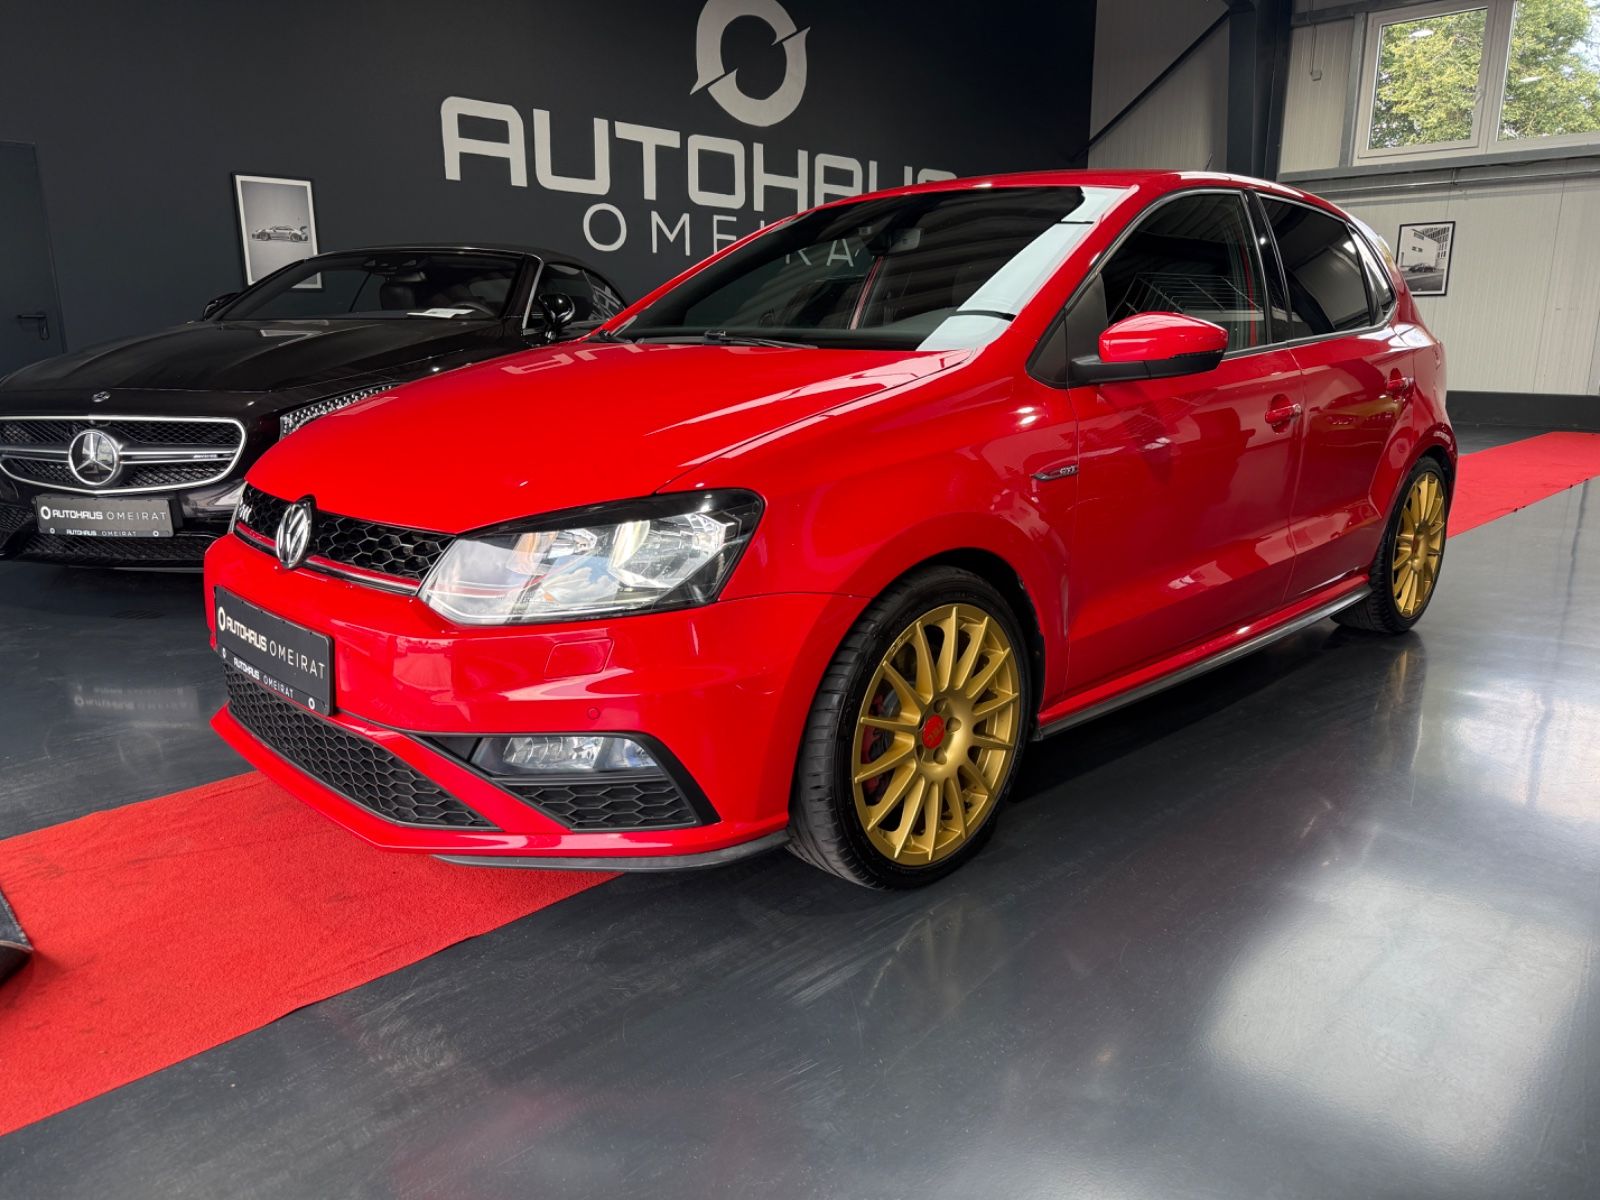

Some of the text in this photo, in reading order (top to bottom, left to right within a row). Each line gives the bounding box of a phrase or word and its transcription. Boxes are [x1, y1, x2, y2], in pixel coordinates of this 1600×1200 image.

[441, 96, 958, 212] AUTOHA
[52, 509, 167, 521] AUTOHAUS OMEIRAT
[66, 528, 97, 536] AUTOHAUS
[226, 617, 326, 680] AUTOHAUS OMEIRAT
[233, 657, 294, 699] AUTOHAUS OMEIRAT
